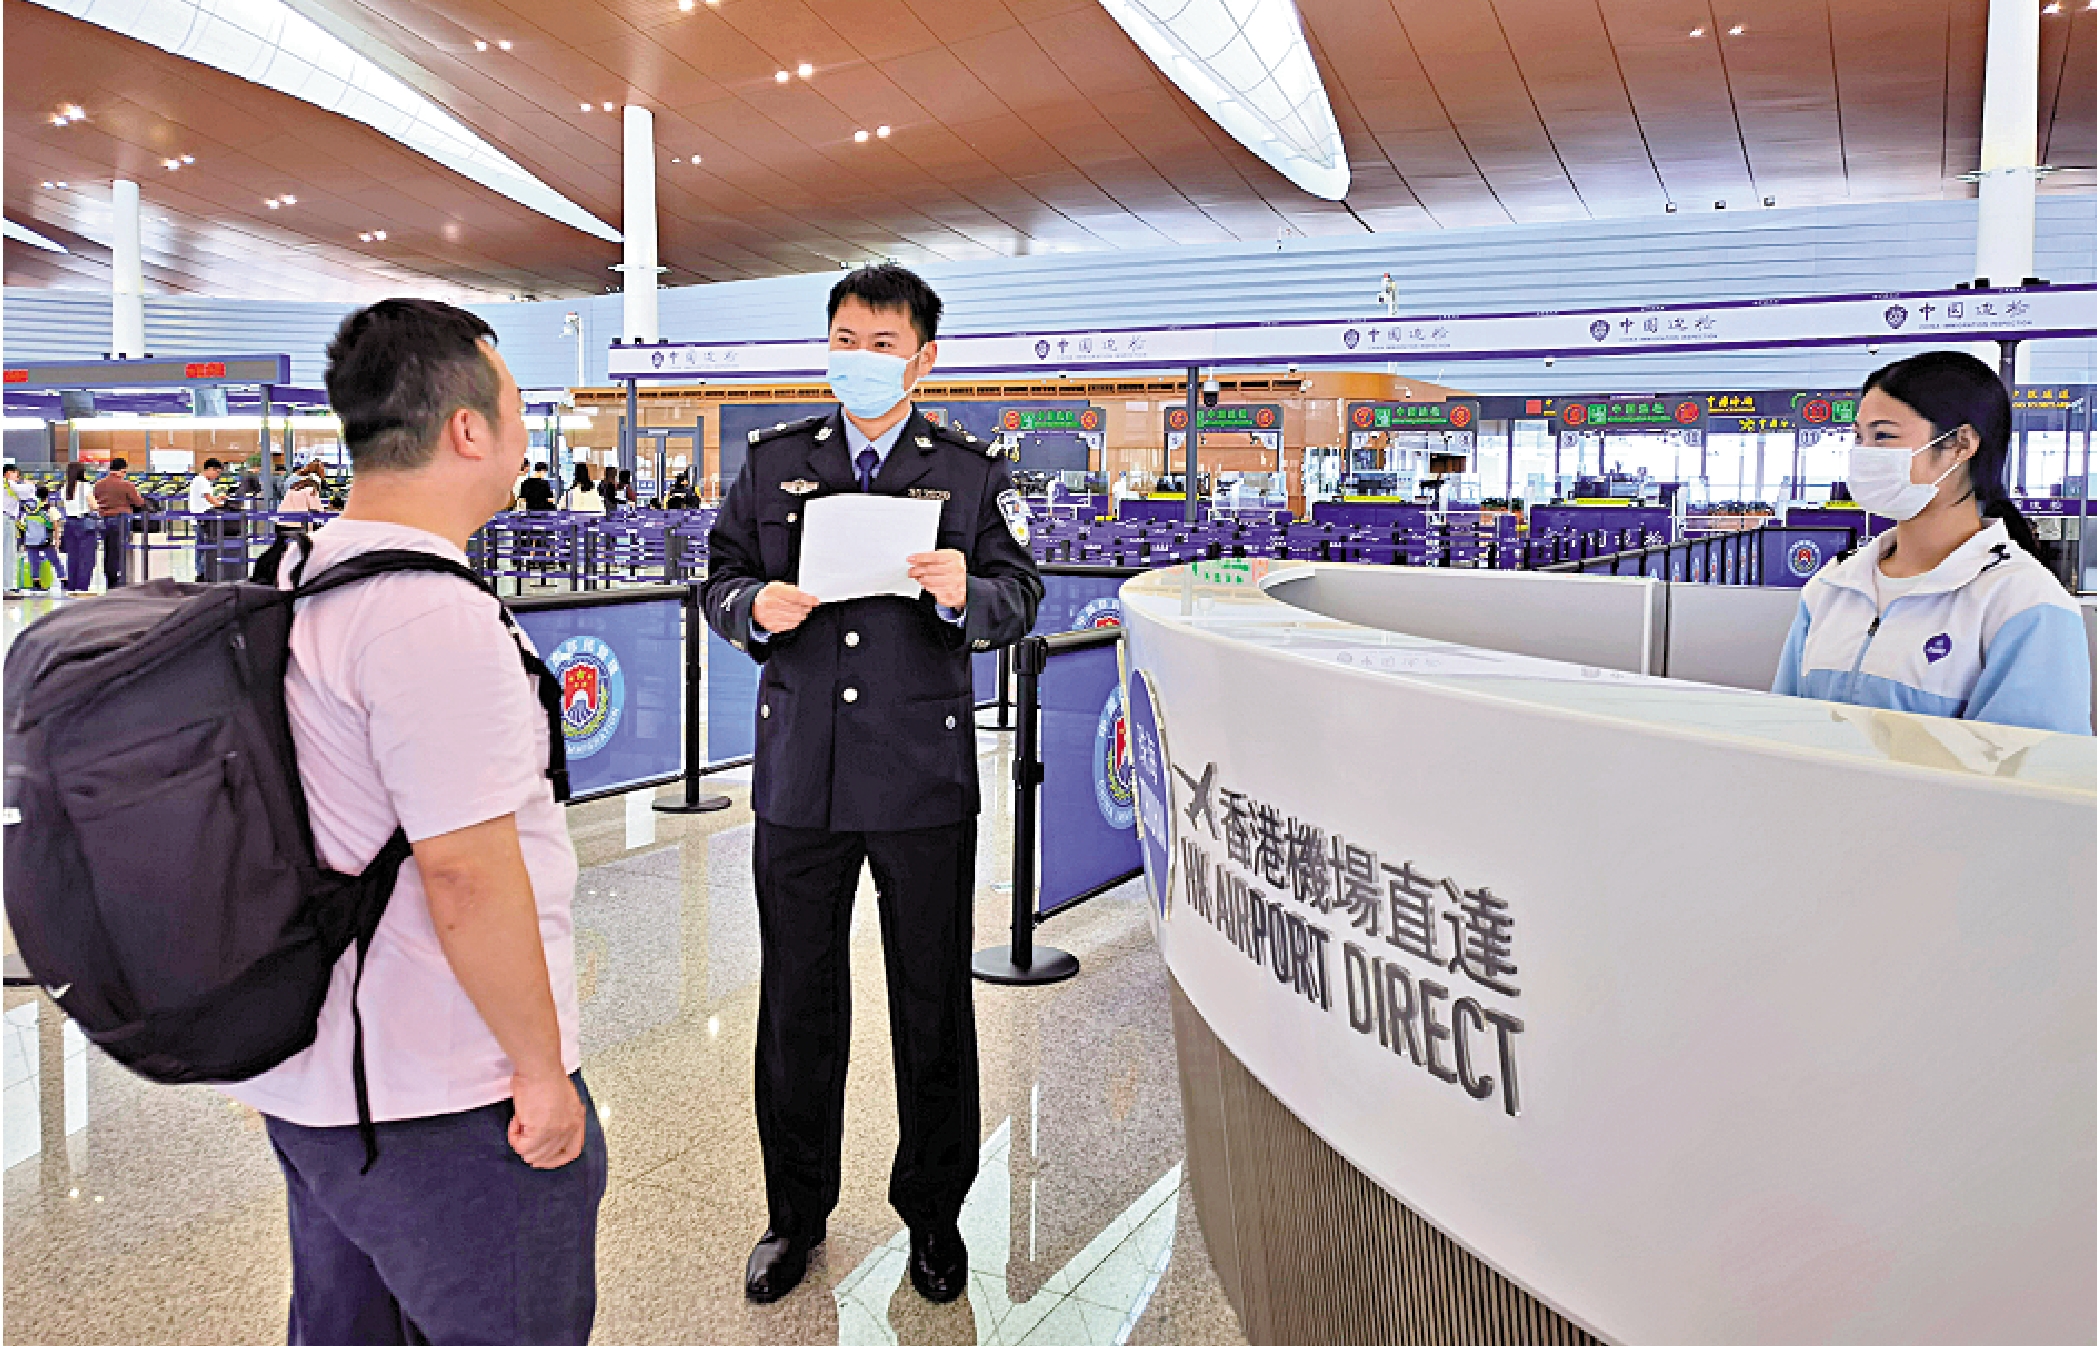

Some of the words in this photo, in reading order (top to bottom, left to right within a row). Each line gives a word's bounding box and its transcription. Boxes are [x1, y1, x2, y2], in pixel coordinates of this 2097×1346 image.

[1216, 863, 1332, 1013] AIRPORT
[1343, 940, 1525, 1118] DIRECT
[1219, 786, 1522, 998] 香港機場直達
